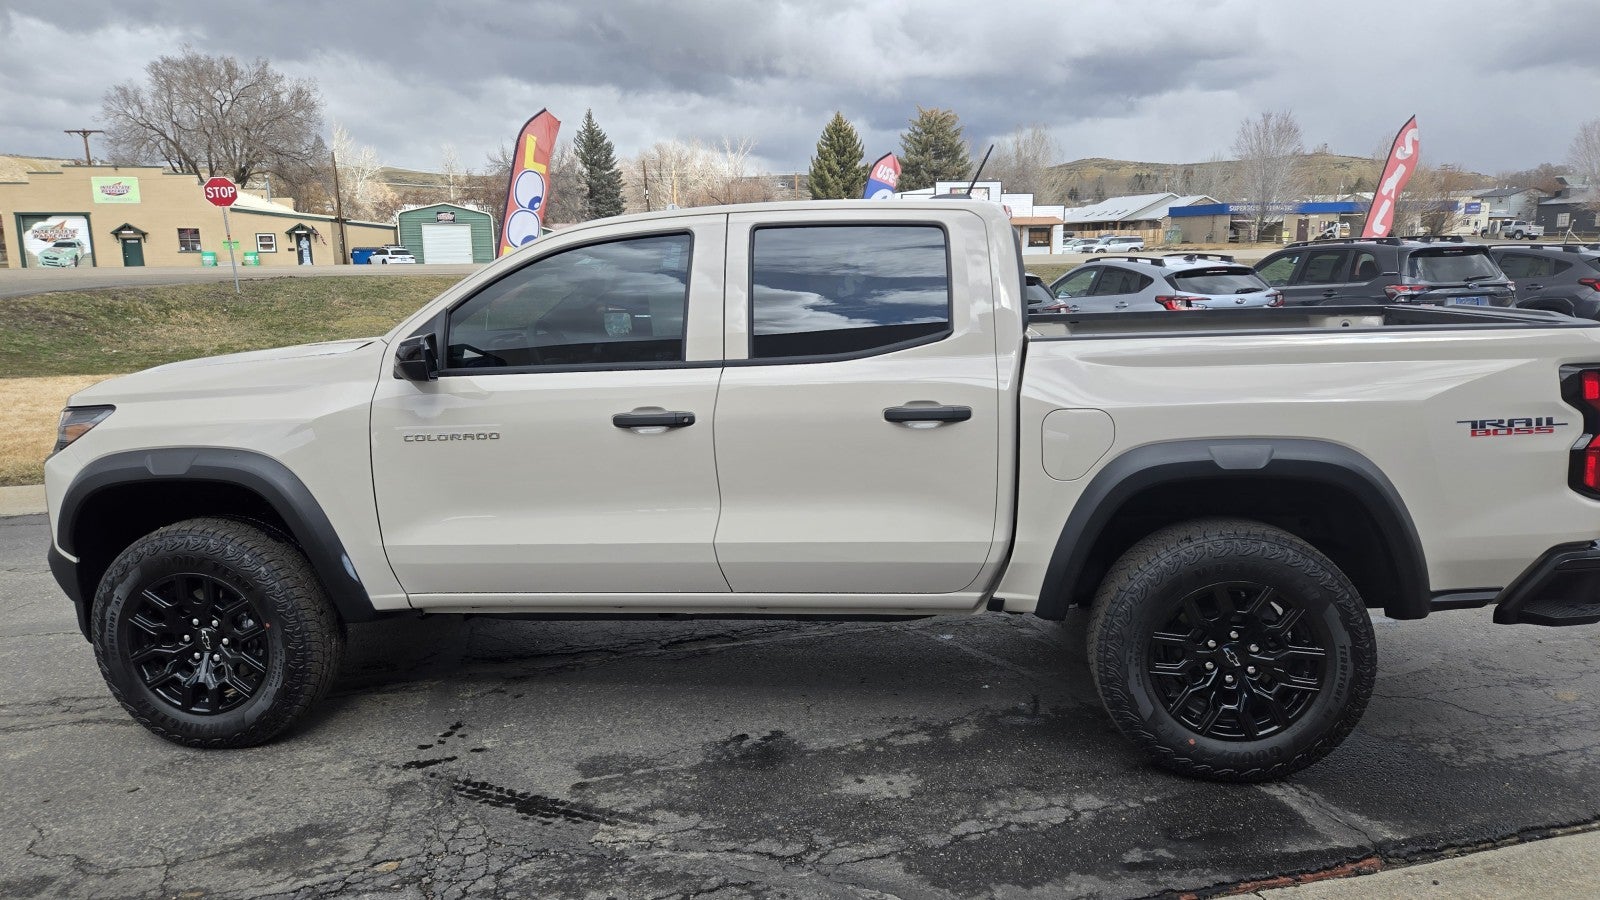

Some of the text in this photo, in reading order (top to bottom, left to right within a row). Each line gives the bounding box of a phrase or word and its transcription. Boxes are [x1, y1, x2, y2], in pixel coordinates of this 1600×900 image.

[876, 164, 896, 185] USE
[1372, 128, 1419, 238] SAL
[206, 186, 236, 199] STOP
[503, 133, 547, 255] LOO
[1457, 417, 1568, 429] TRAIL
[403, 432, 501, 443] COLORADO
[1471, 426, 1555, 437] BOSS
